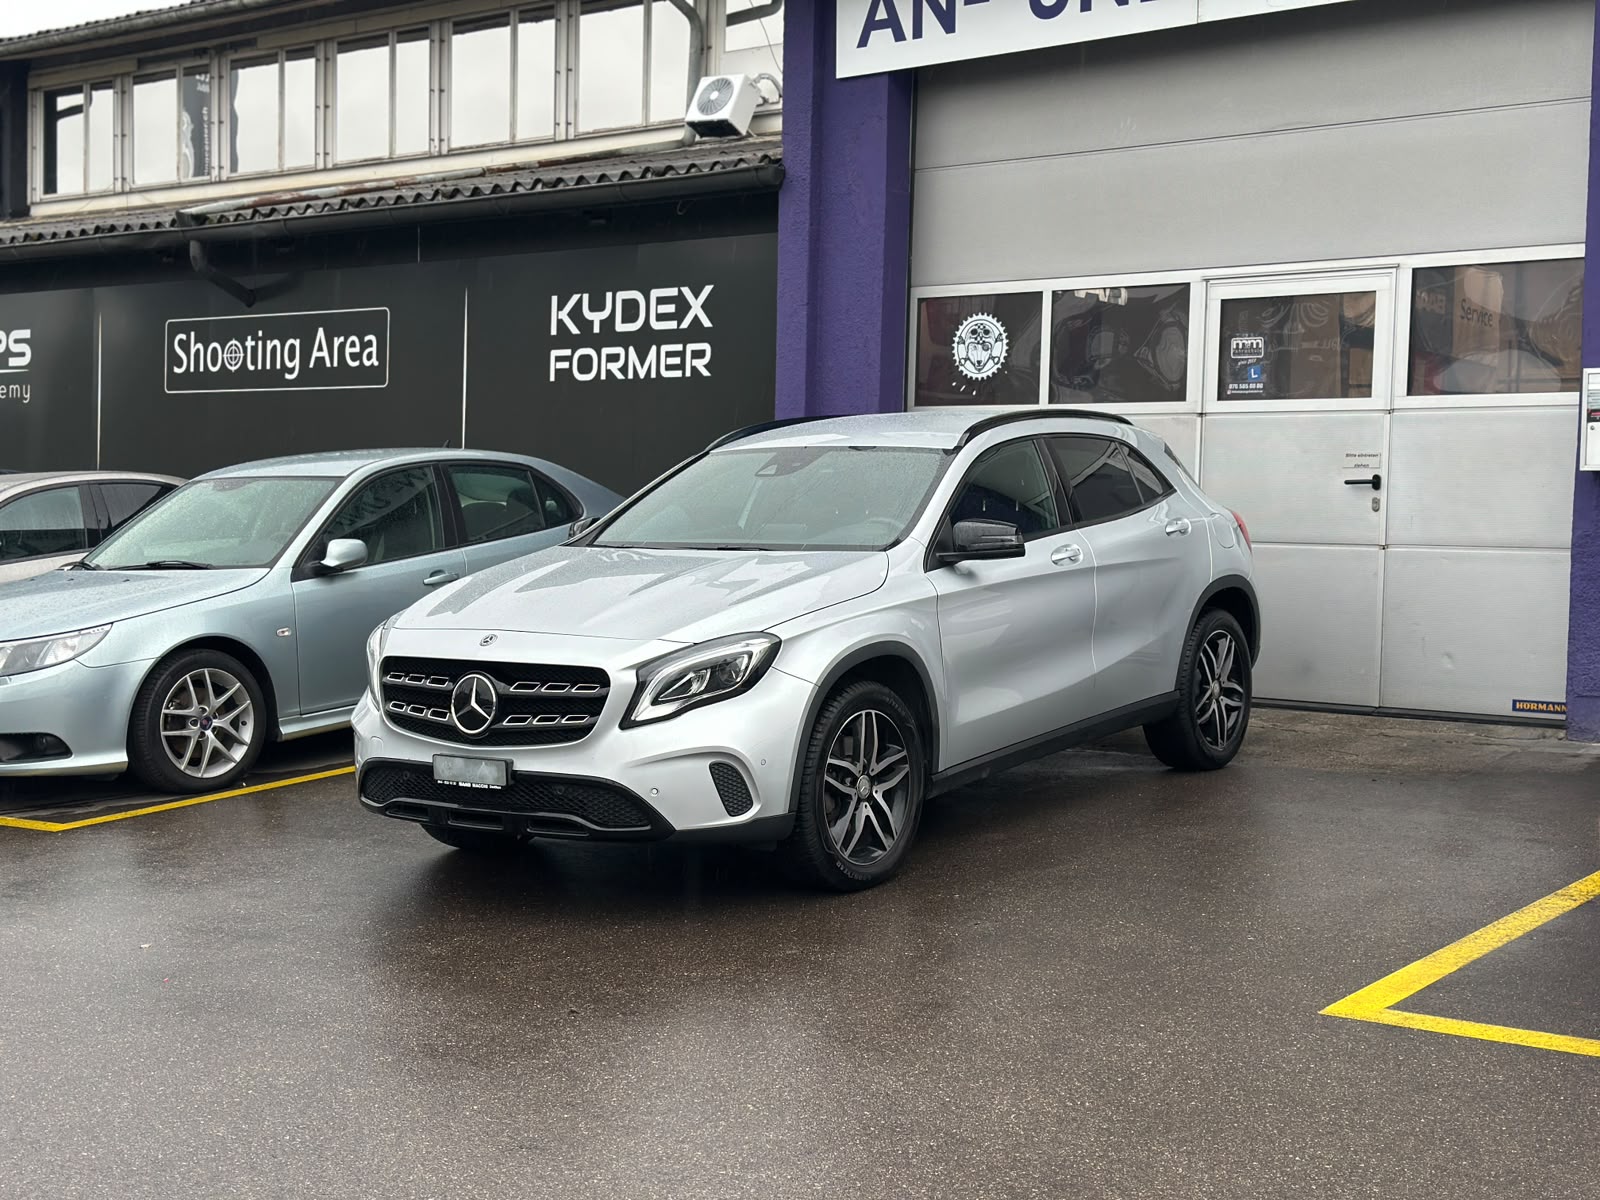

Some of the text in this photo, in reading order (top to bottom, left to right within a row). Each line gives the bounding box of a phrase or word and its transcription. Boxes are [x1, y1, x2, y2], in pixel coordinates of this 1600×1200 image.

[550, 284, 715, 336] KYDEX
[1460, 298, 1494, 328] Service
[173, 327, 379, 380] Shooting Area
[549, 342, 712, 382] FORMER
[1251, 368, 1258, 379] L
